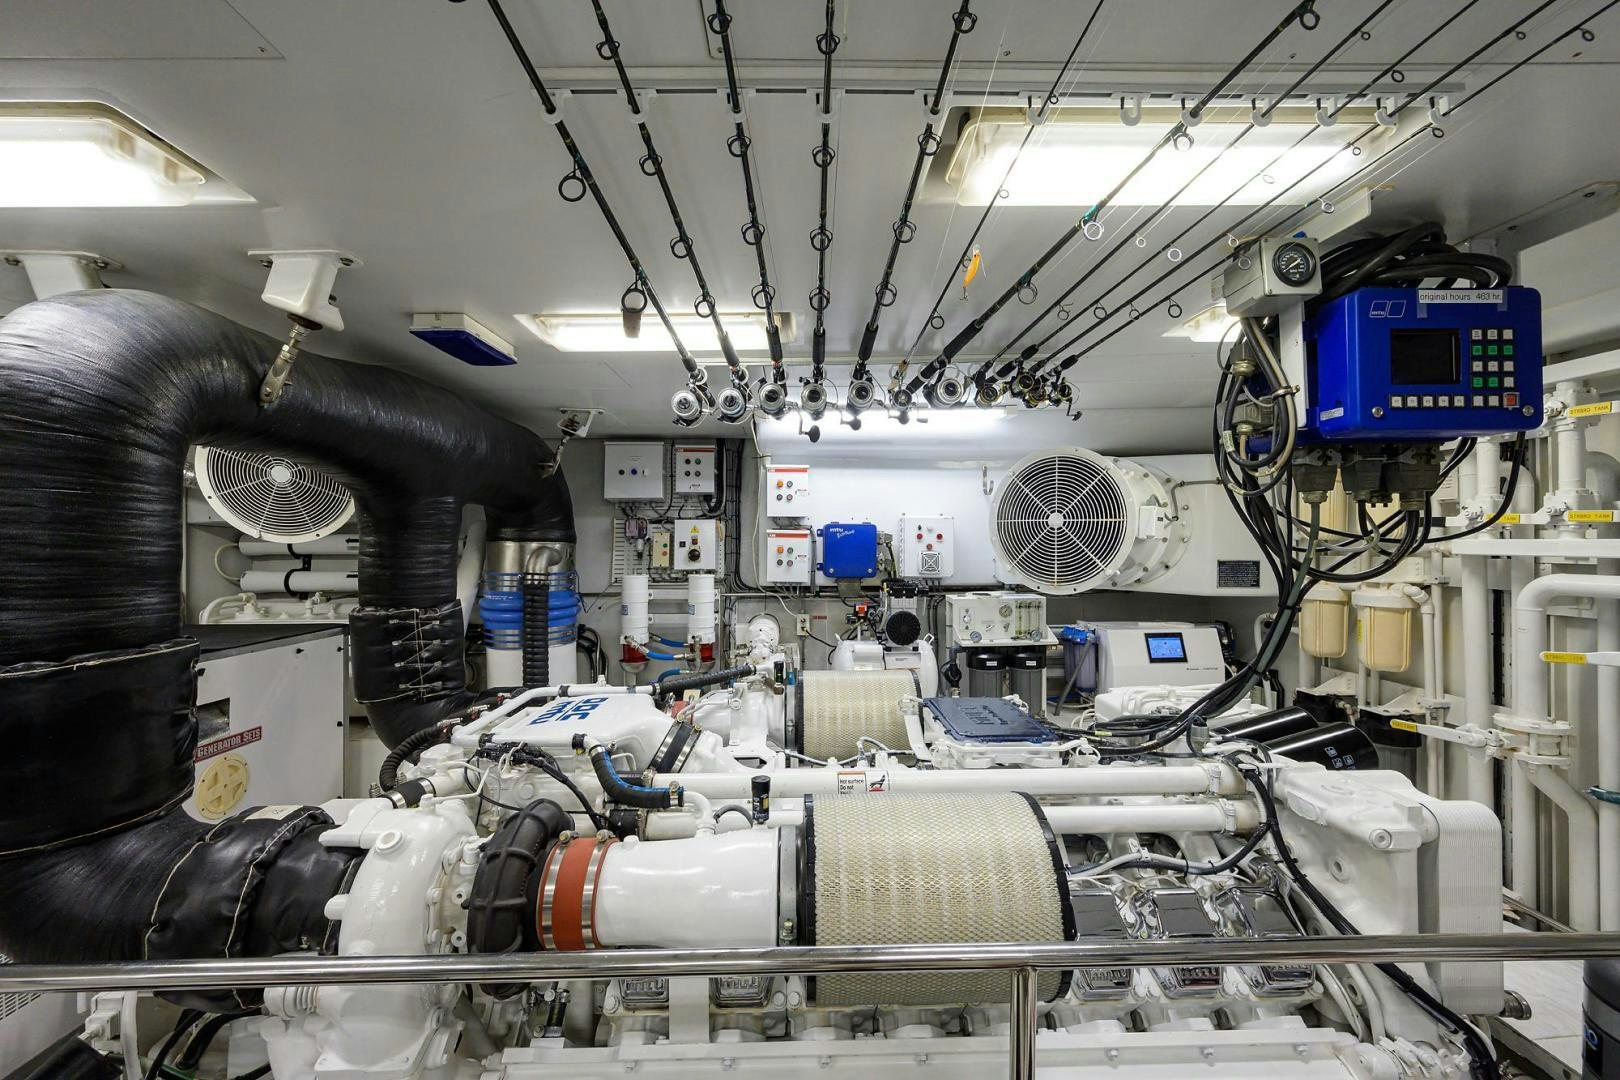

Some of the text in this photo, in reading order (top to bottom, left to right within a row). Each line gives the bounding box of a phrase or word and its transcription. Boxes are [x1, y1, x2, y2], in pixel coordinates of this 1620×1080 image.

[1419, 292, 1448, 302] original
[1449, 292, 1471, 301] hours
[1475, 292, 1490, 301] 463
[197, 728, 261, 758] GENERATOR SETS
